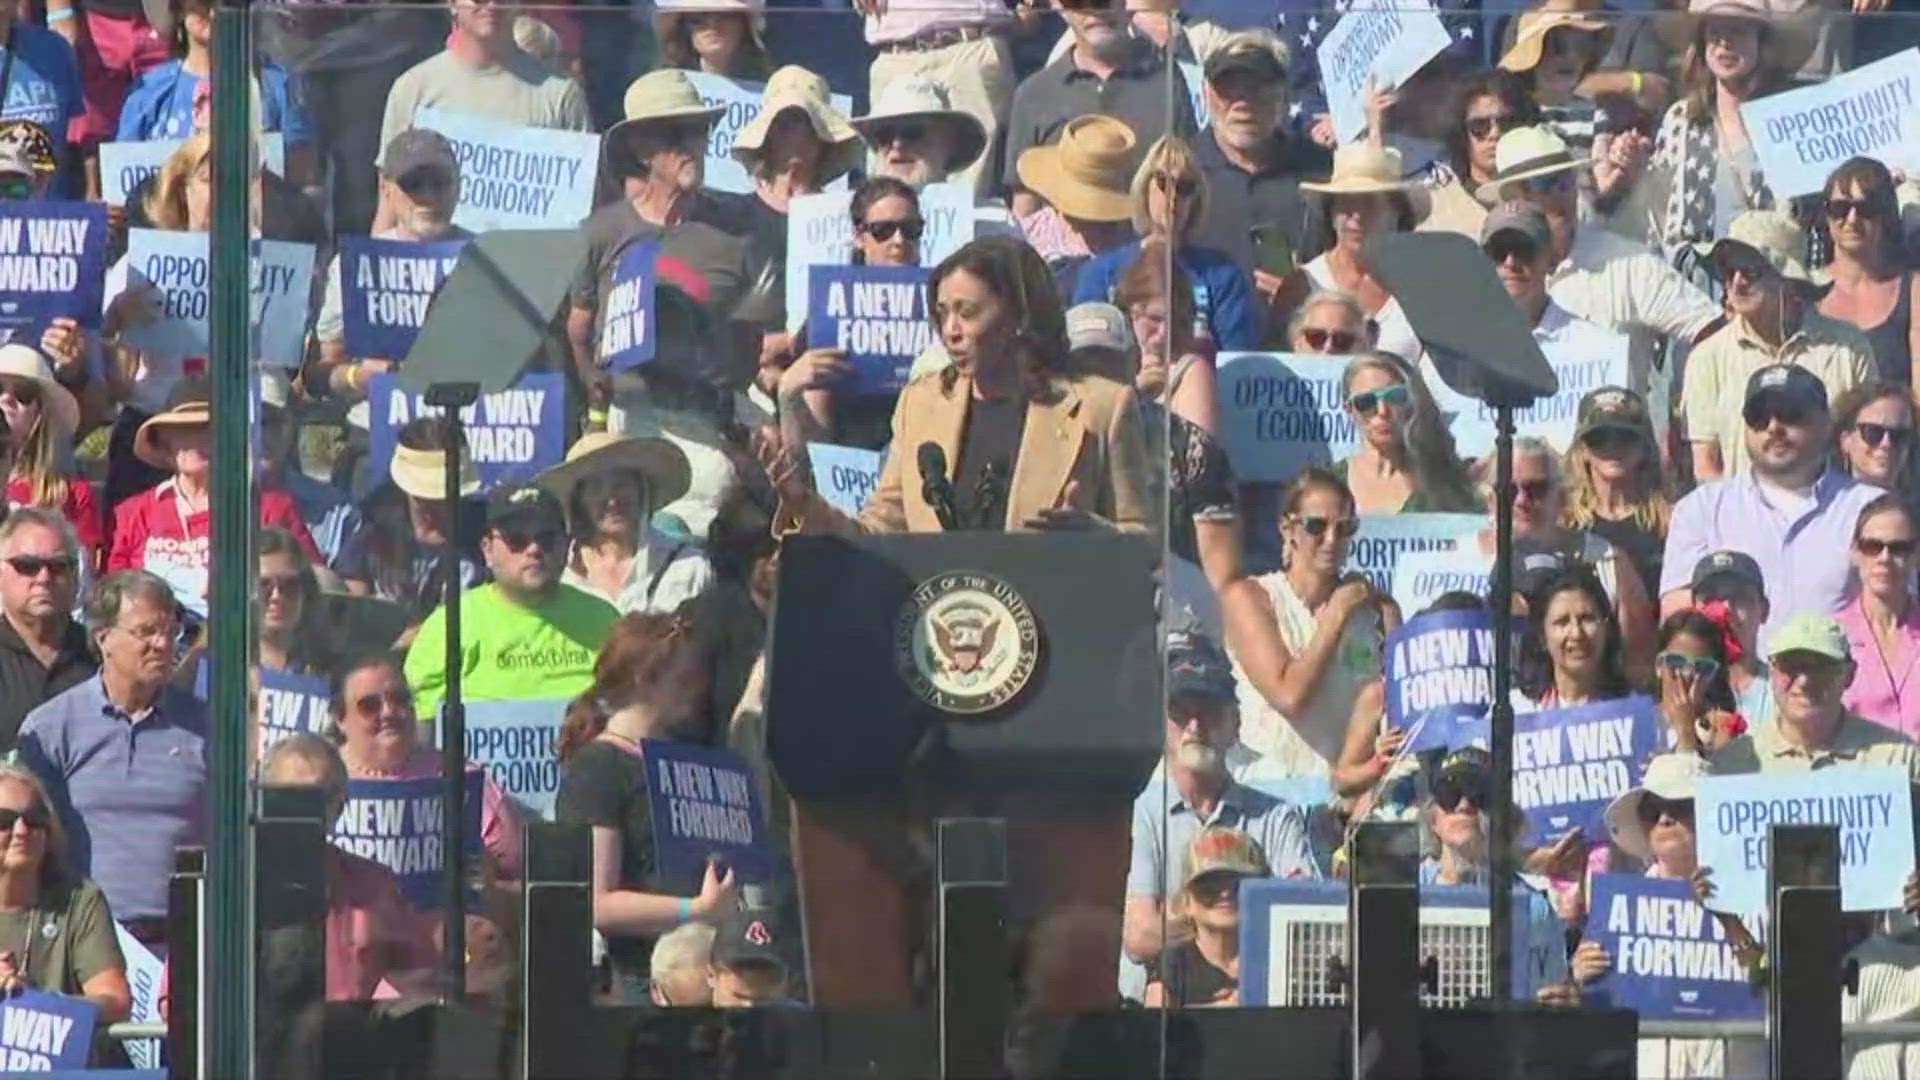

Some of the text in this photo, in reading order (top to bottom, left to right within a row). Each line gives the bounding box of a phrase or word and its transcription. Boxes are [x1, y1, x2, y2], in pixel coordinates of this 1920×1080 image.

[1767, 75, 1913, 144] OPPORTUNITY
[1796, 113, 1902, 165] ECONOMY
[26, 218, 90, 256] WAY
[356, 252, 374, 289] A
[379, 254, 437, 292] NEW
[827, 281, 847, 317] A
[853, 281, 916, 318] NEW
[388, 388, 409, 426] A
[483, 389, 546, 426] WAY
[1256, 409, 1356, 444] ECONOM
[993, 582, 1035, 642] UNITED
[1408, 628, 1470, 676] NEW
[1566, 716, 1635, 763] WAY
[658, 758, 750, 809] A NEW WAY
[669, 797, 753, 845] FORWARD
[1717, 792, 1893, 836] OPPORTUNITY
[1608, 894, 1629, 933] A
[1635, 895, 1704, 940] NEW
[2, 1005, 74, 1057] WAY
